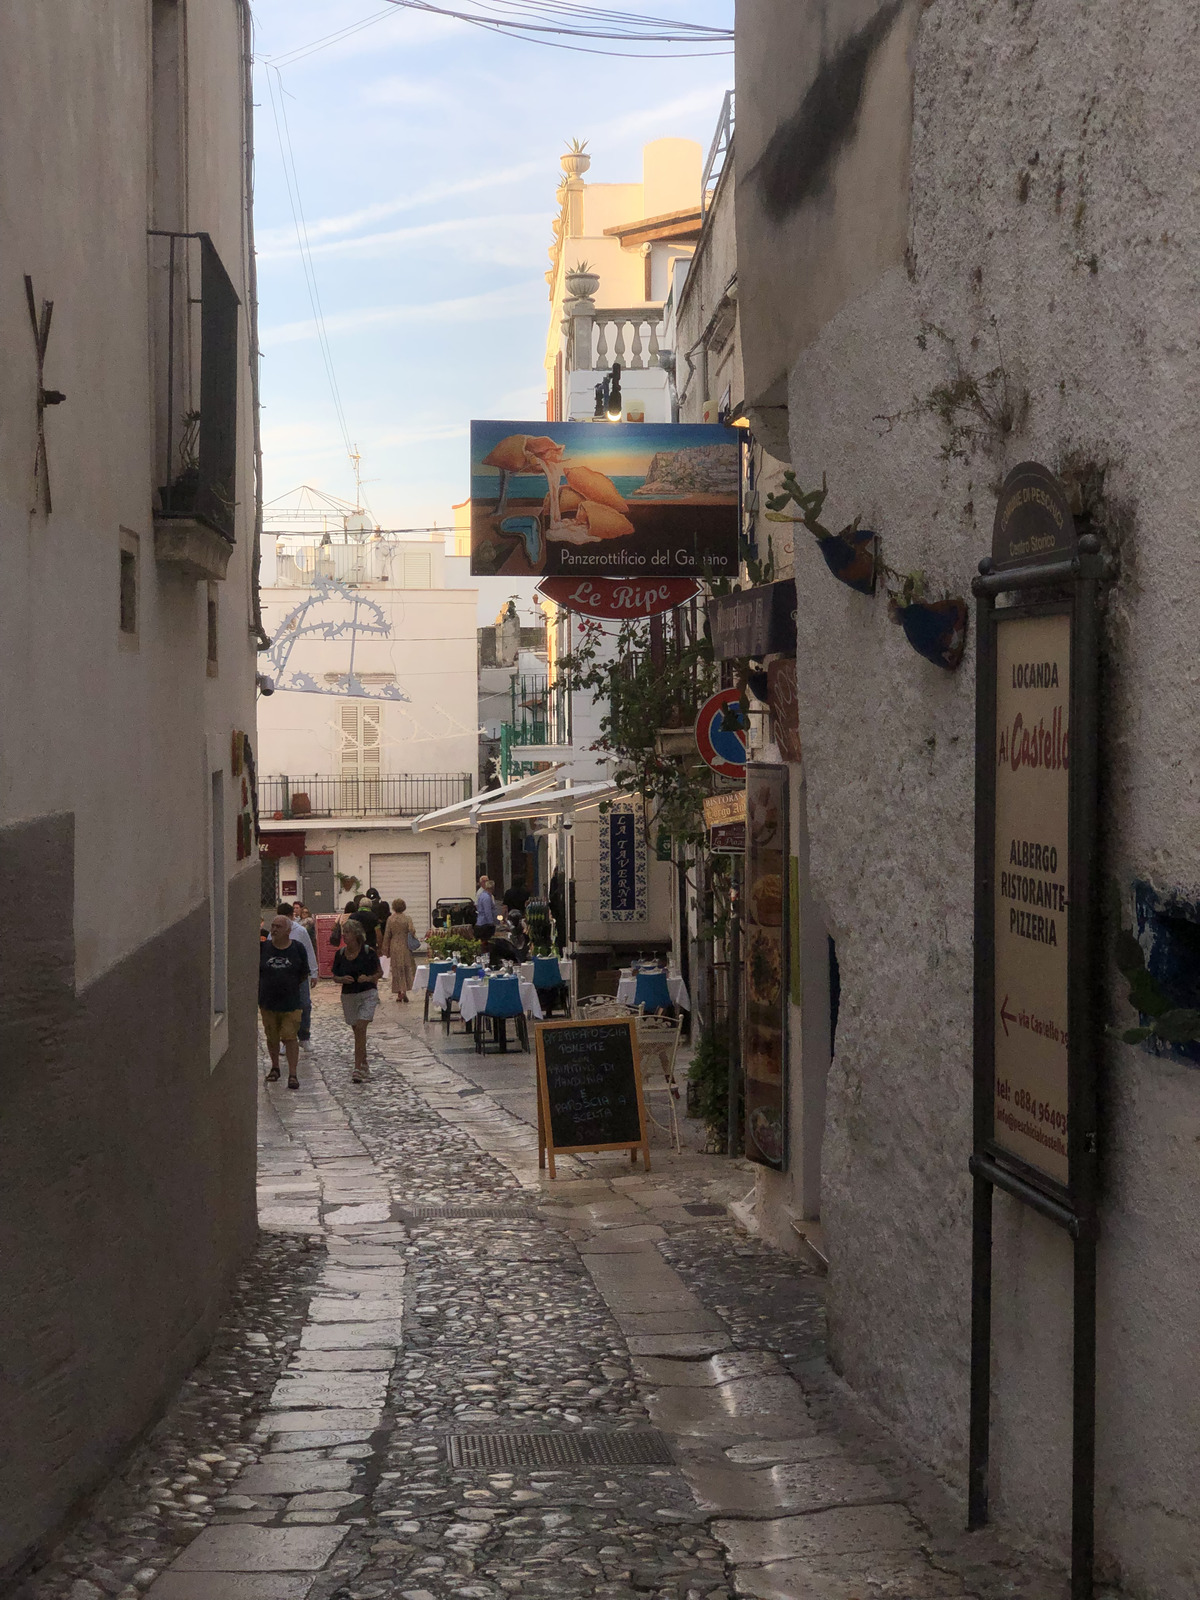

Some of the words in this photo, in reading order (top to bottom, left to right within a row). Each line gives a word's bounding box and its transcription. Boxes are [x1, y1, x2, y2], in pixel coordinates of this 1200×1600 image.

[1022, 487, 1030, 502] DI
[561, 549, 646, 565] Panzerottificio
[651, 549, 670, 565] del
[675, 548, 728, 566] Gaano
[1030, 532, 1056, 552] Storico
[568, 581, 602, 607] Le
[610, 584, 671, 613] Ripe
[1012, 662, 1059, 689] LOCANDA
[1010, 705, 1070, 772] Castello
[615, 815, 627, 836] LA
[1009, 839, 1058, 874] ALBERGO
[616, 840, 631, 908] TAVERNA
[1001, 871, 1066, 913] RISTORANTE
[1009, 907, 1058, 947] PIZZERIA
[1018, 1008, 1030, 1029] via
[1030, 1014, 1059, 1042] Castello
[996, 1077, 1010, 1102] tel:
[1014, 1088, 1036, 1119] 0884
